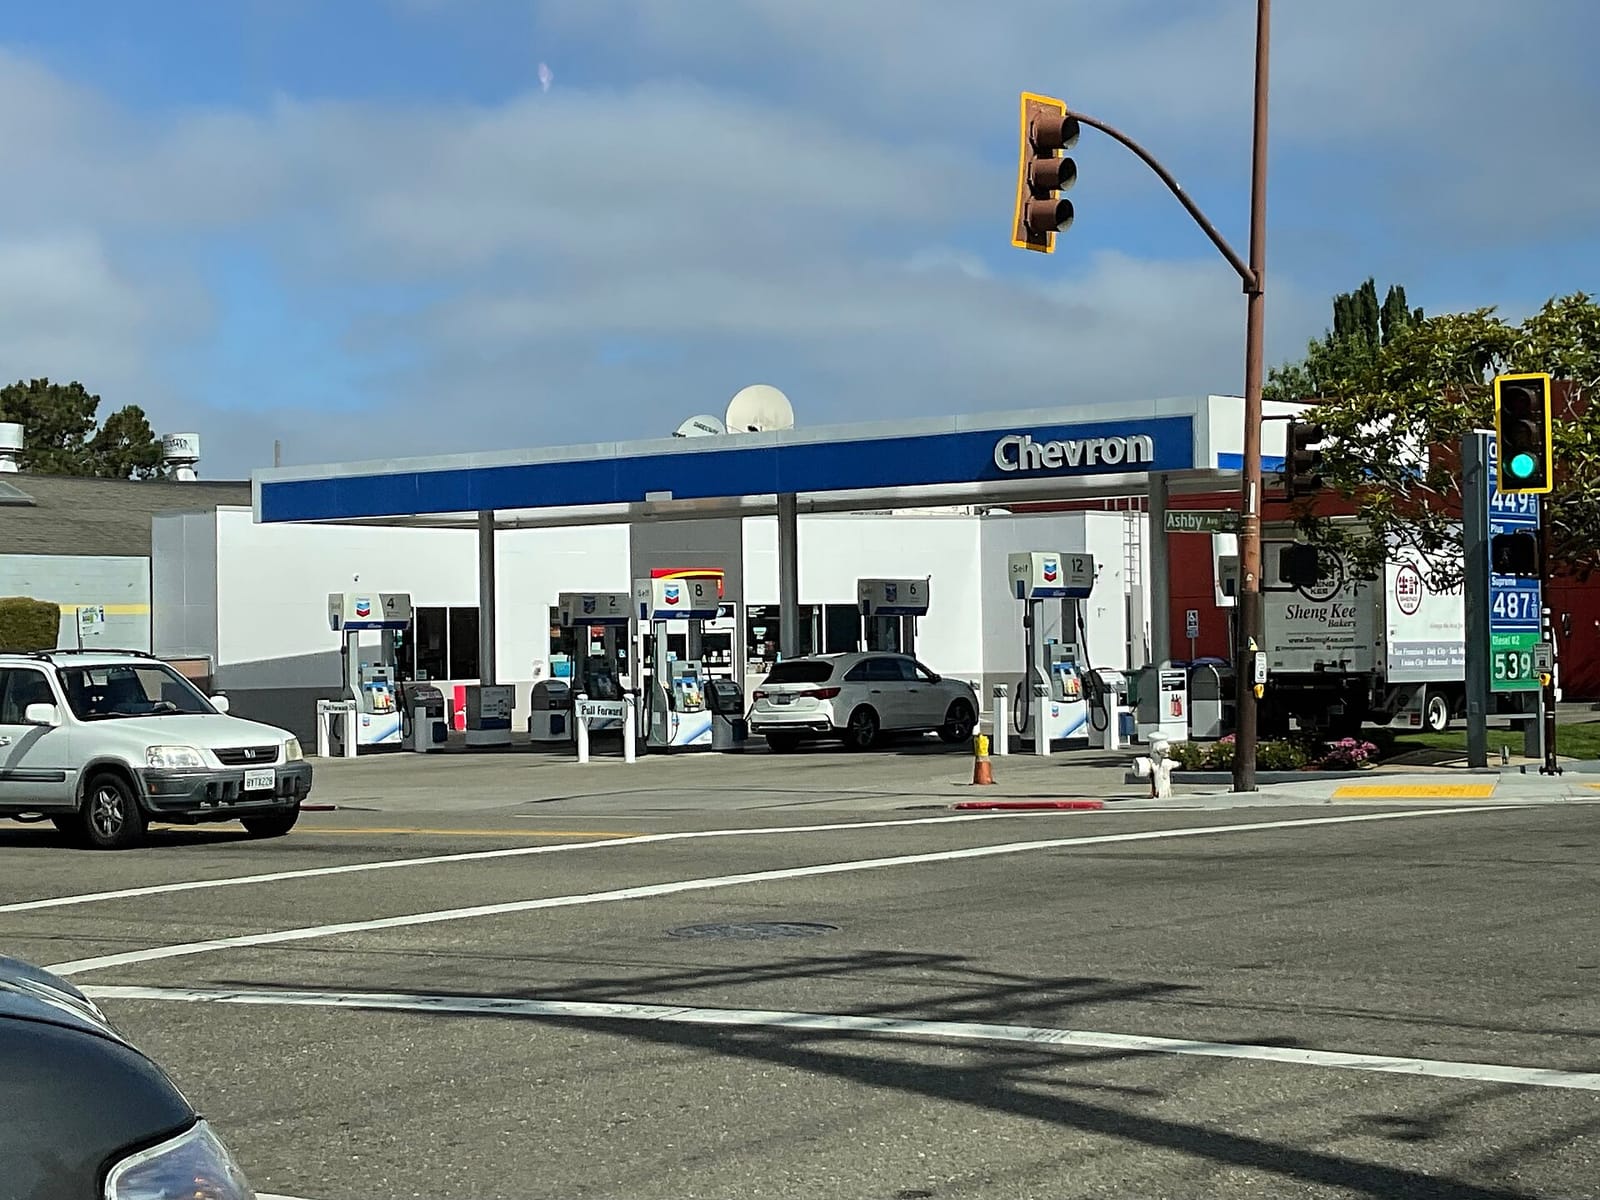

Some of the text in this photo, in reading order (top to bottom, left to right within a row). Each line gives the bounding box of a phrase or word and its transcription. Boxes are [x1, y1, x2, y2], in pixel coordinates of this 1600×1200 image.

[994, 434, 1154, 472] Chevron
[1491, 493, 1528, 512] 449
[1167, 513, 1219, 531] Ashby Ave
[1490, 524, 1504, 533] Plus
[1013, 564, 1029, 573] Self
[1071, 558, 1084, 573] 12
[1490, 576, 1517, 587] Supreme
[695, 584, 702, 597] 8
[910, 583, 917, 595] 6
[386, 597, 395, 609] 4
[609, 596, 616, 607] 2
[1493, 592, 1529, 618] 487
[1285, 603, 1357, 622] Sheng Kee
[1495, 653, 1531, 679] 539
[581, 705, 623, 717] Pull Forward
